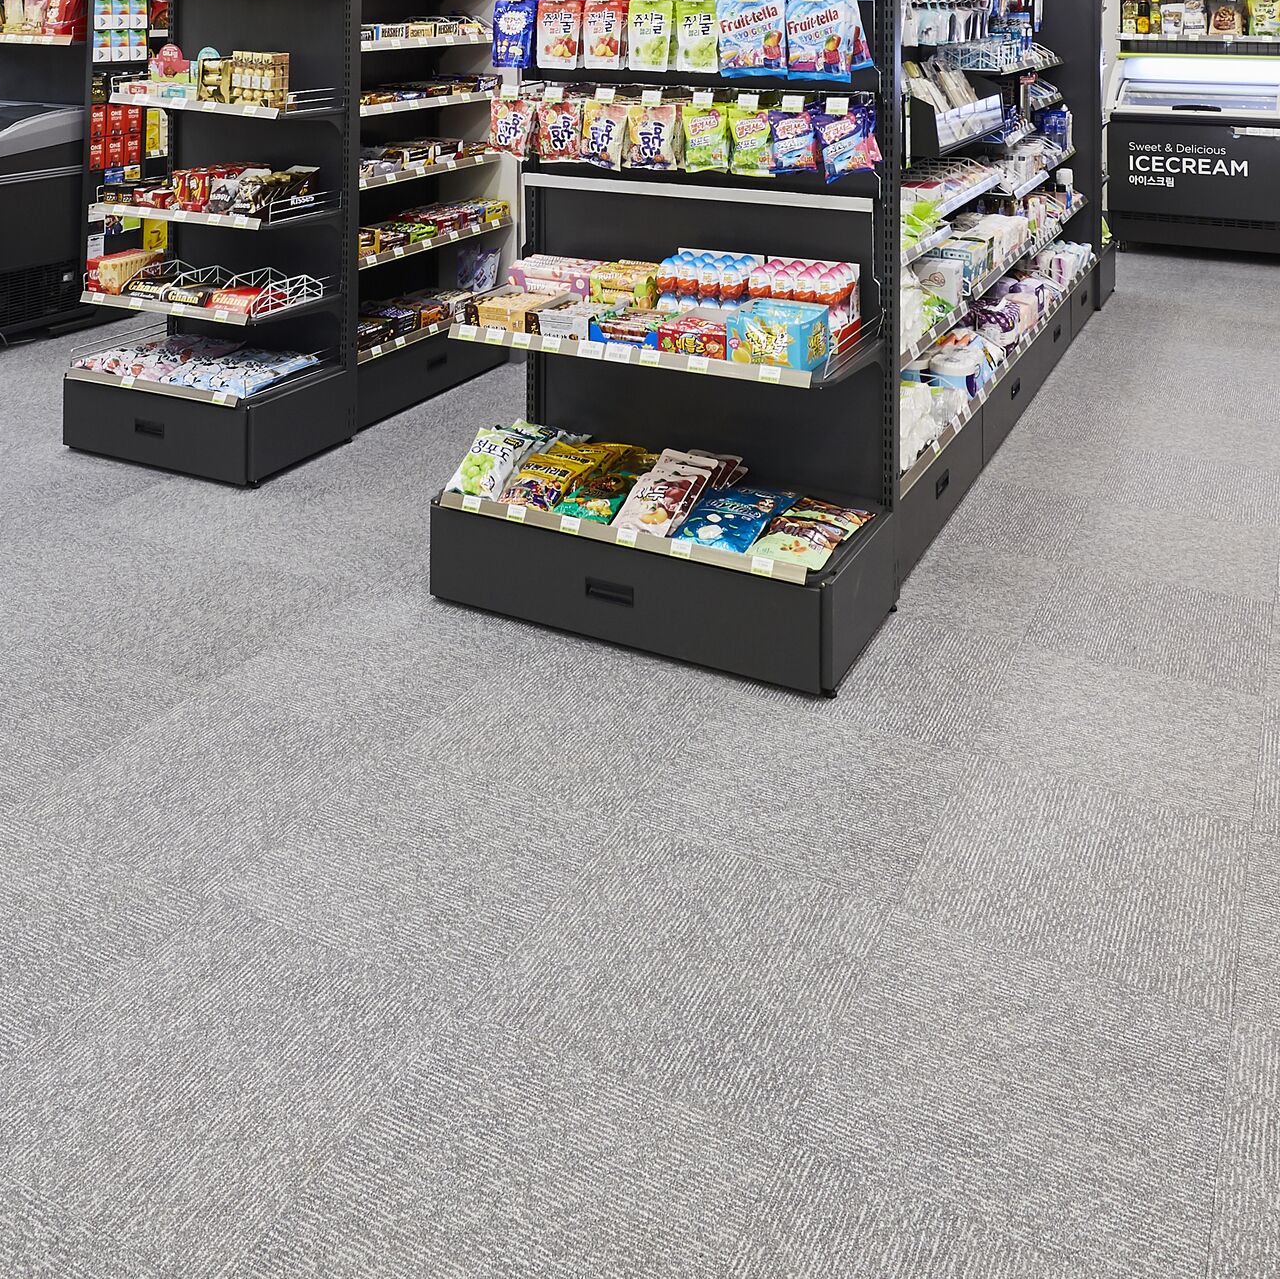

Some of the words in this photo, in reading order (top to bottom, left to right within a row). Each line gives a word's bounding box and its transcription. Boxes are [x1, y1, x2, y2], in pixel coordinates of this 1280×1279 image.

[542, 11, 575, 34] 쥬시쿨
[587, 10, 616, 33] 쥬시쿨
[632, 12, 665, 35] 쥬시쿨
[683, 13, 714, 36] 쥬시쿨
[1128, 141, 1162, 153] Sweet
[1164, 143, 1173, 153] &
[1176, 144, 1227, 155] Delicious
[1128, 155, 1249, 177] ICECREAM
[1128, 174, 1175, 187] 아이스크림
[168, 291, 199, 304] Ghana
[211, 293, 249, 307] Ghana
[675, 336, 706, 355] 비틀즈
